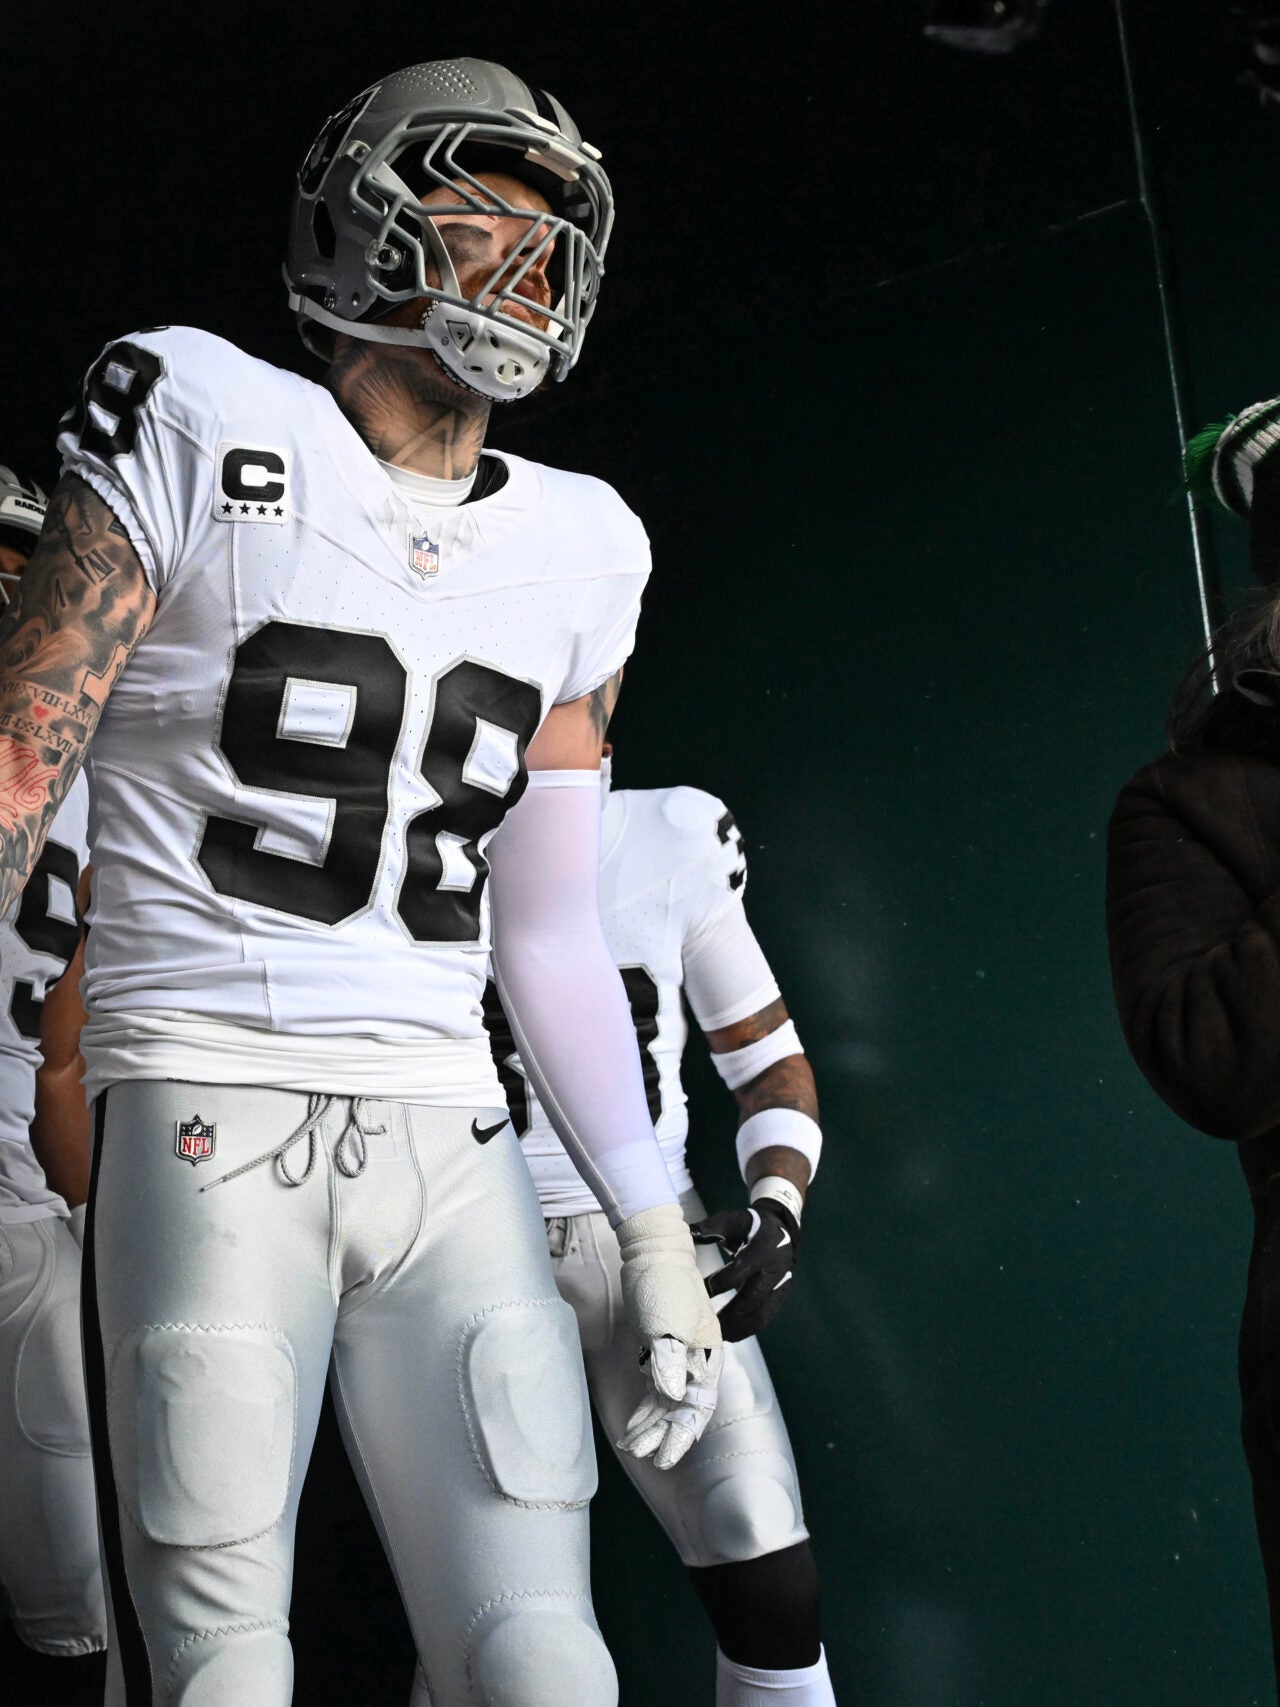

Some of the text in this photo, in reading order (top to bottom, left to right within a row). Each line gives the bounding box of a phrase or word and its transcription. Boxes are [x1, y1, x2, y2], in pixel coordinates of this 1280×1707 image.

[220, 446, 286, 504] C
[190, 617, 545, 947] 98
[181, 1136, 211, 1157] NFL
